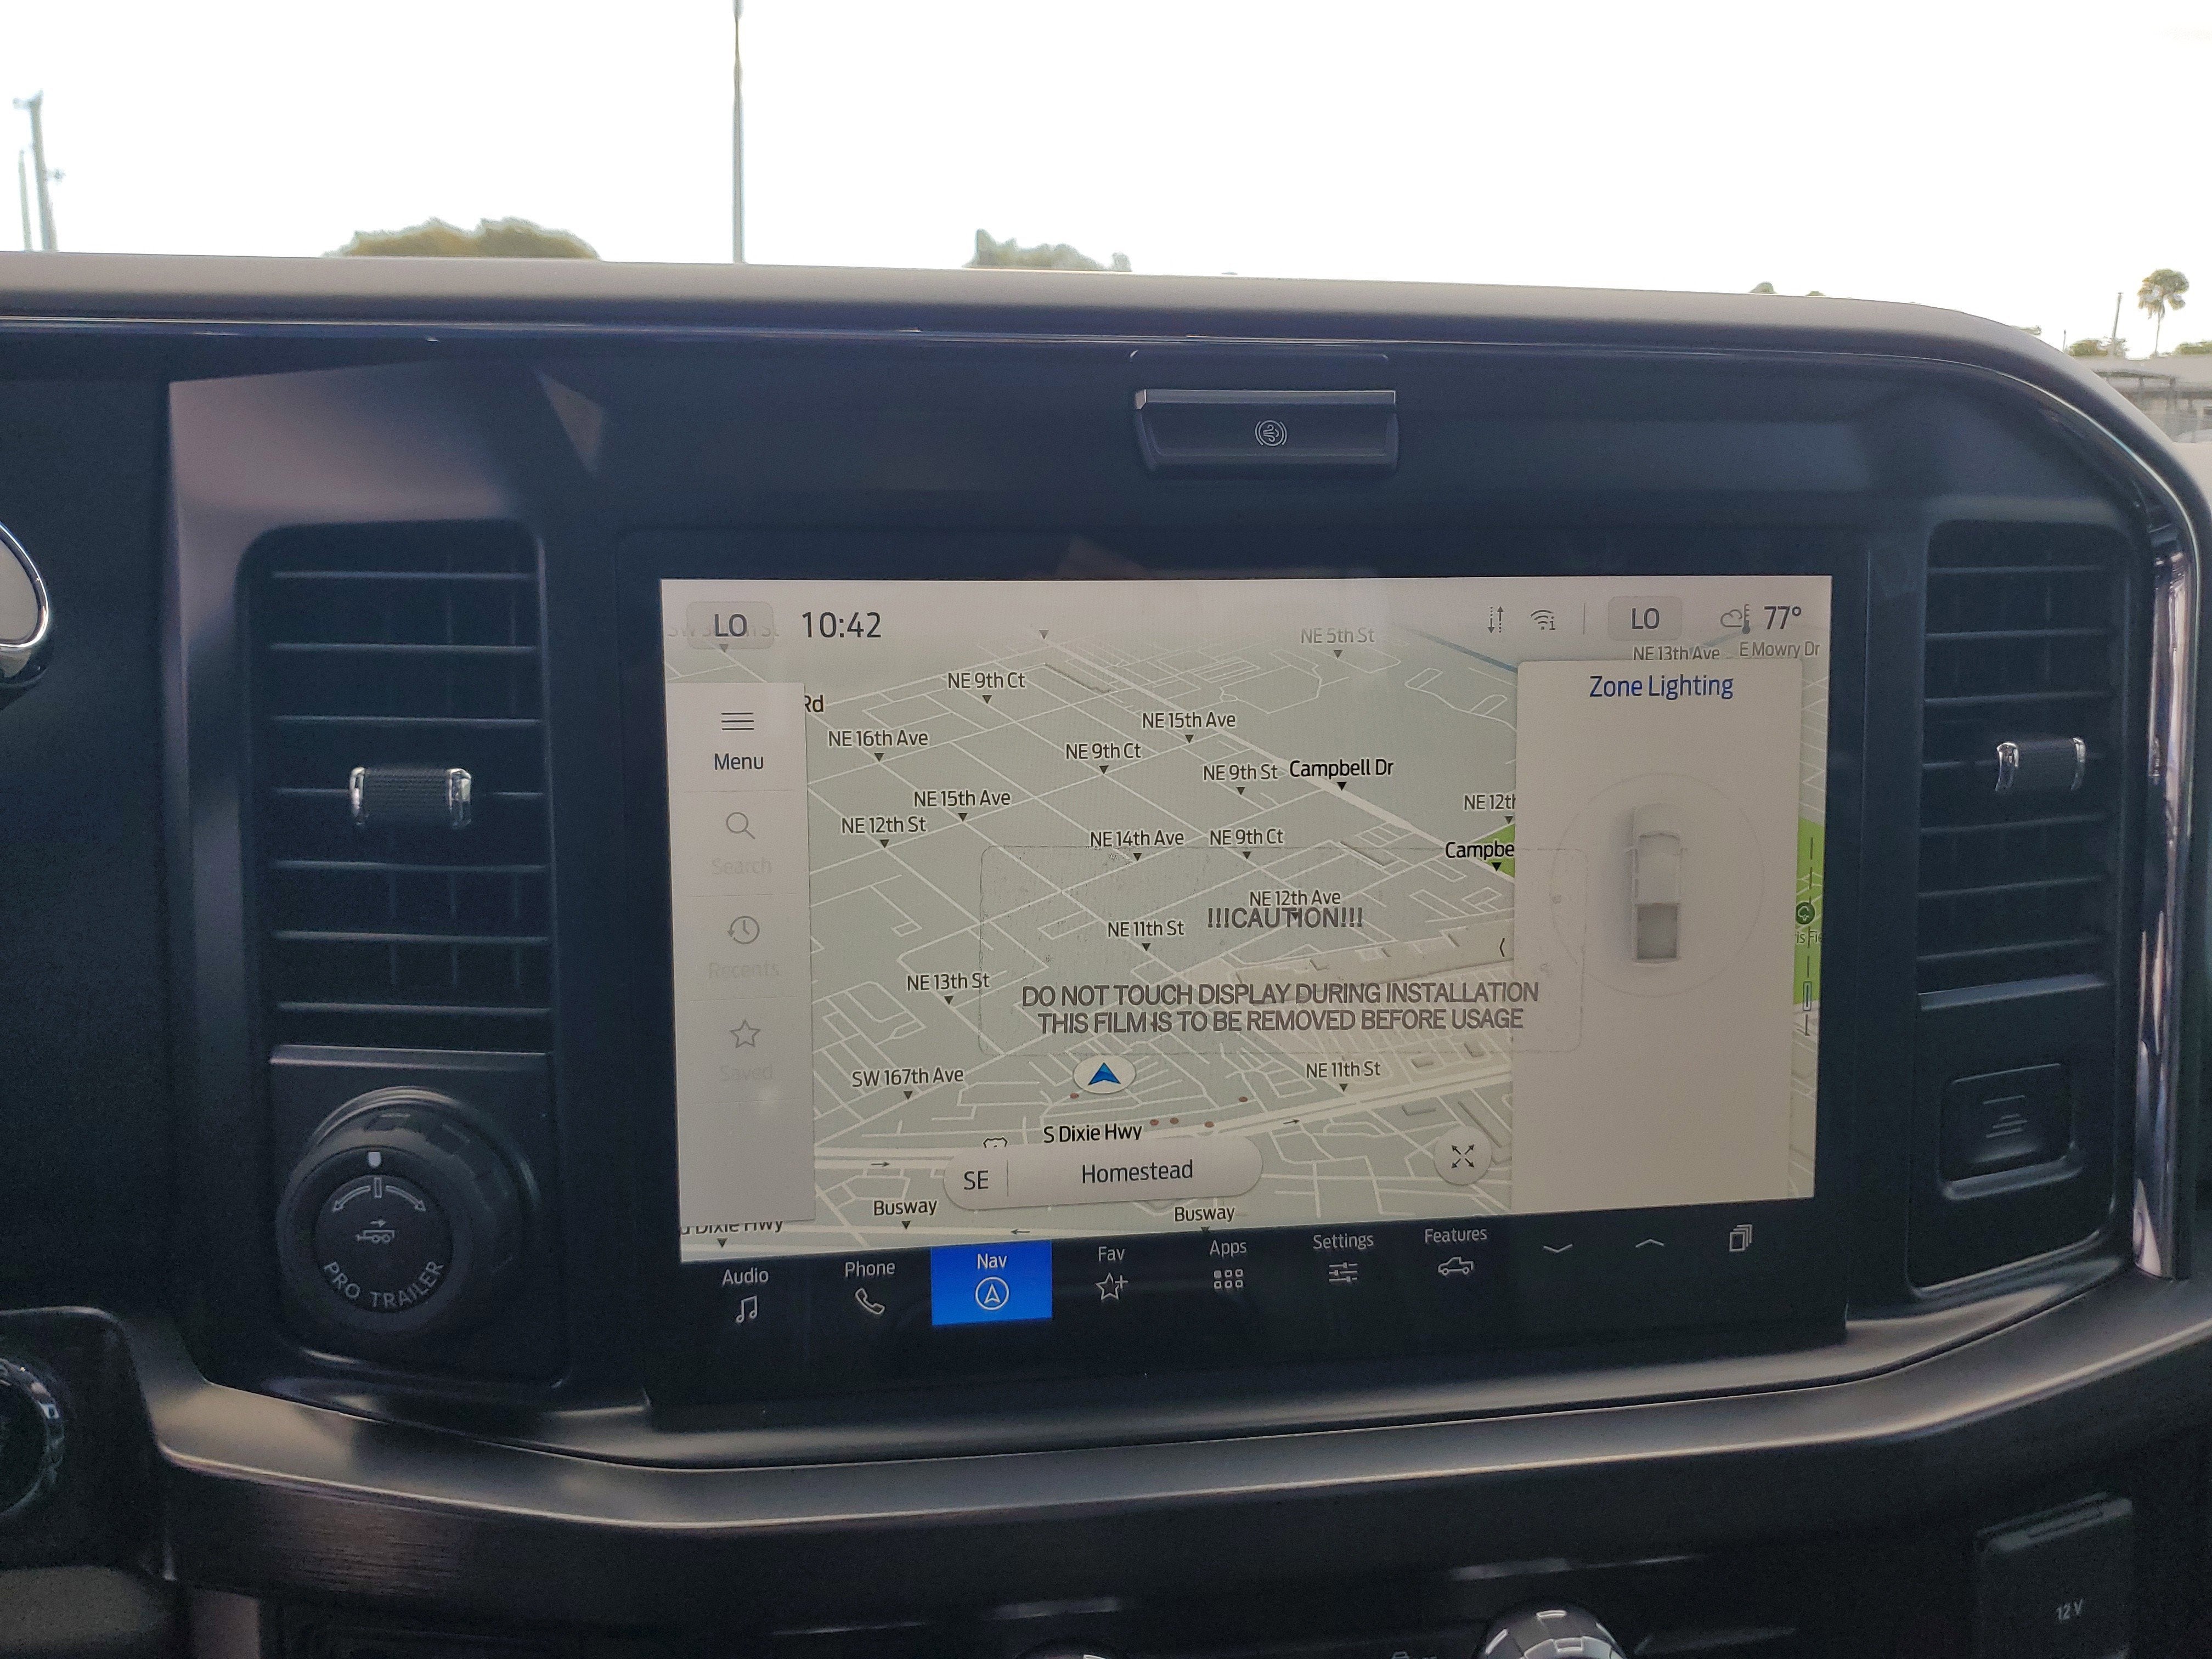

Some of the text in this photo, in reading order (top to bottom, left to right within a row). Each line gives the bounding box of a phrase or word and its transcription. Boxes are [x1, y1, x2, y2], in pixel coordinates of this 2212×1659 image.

[714, 613, 747, 637] LO
[802, 612, 882, 638] 10:42
[1631, 607, 1660, 630] LO
[1301, 627, 1375, 644] NE 5th St
[1633, 646, 1720, 661] NE 13th Ave
[1740, 641, 1821, 659] E Mowry Dr
[947, 672, 1025, 689] NE 9th Ct
[1589, 673, 1734, 701] Zone Lighting
[804, 694, 824, 713] Rd
[1142, 712, 1236, 729] NE 15th Ave
[828, 730, 929, 747] NE 16th Ave
[1065, 743, 1141, 759] NE 9th Ct
[714, 753, 765, 771] Menu
[1289, 759, 1394, 781] Campbell Dr
[1203, 765, 1278, 781] NE 9th St
[913, 791, 1011, 807] NE 15th Ave
[1464, 794, 1486, 810] NE
[841, 817, 927, 833] NE 12th St
[1090, 831, 1184, 847] NE 14th Ave
[1210, 828, 1284, 845] NE 9th Ct
[712, 856, 772, 875] Search
[1249, 890, 1341, 906] NE 12th Ave
[1107, 920, 1184, 938] NE 11th St
[708, 961, 780, 980] Recents
[906, 973, 990, 991] NE 13th St
[1022, 981, 1538, 1007] DO NOT TOUCH DISPLAY DURING INSTALLATION
[1038, 1008, 1524, 1034] THIS FILM IS TO BE REMOVED BEFORE USAGE
[720, 1063, 773, 1082] Saved
[852, 1068, 964, 1087] SW 167th Ave
[1306, 1061, 1381, 1079] NE 11th St
[1043, 1123, 1143, 1143] S Dixie Hwy
[963, 1170, 989, 1190] SE
[1081, 1159, 1193, 1184] Homestead
[873, 1199, 938, 1218] Busway
[1174, 1205, 1235, 1223] Busway
[1312, 1233, 1374, 1251] Settings
[1424, 1227, 1488, 1244] Features
[1098, 1246, 1126, 1262] Fav
[1209, 1239, 1248, 1259] Apps
[844, 1261, 896, 1278] Phone
[977, 1254, 1007, 1269] Nav
[324, 1260, 444, 1307] PRO TRAILER
[722, 1268, 769, 1285] Audio
